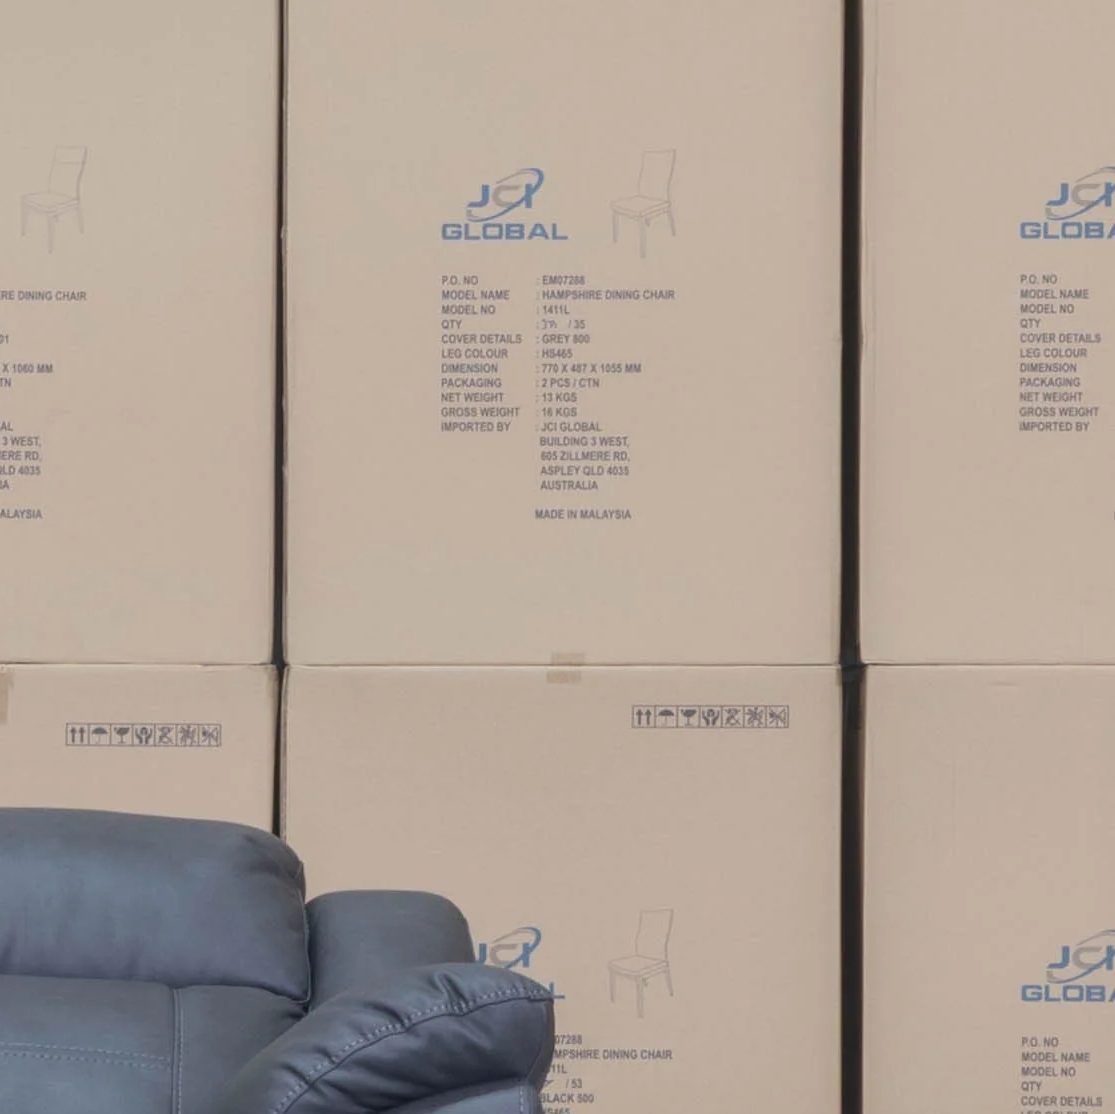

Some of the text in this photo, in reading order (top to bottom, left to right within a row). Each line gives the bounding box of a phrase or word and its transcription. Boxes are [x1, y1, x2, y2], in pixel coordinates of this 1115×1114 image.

[442, 223, 568, 240] GLOBAL
[18, 290, 53, 301] DINING
[55, 290, 87, 301] CHAIR
[441, 290, 510, 300] MODEL NAME
[542, 290, 675, 300] HAMPSHIRE DINING CHAIR
[1020, 289, 1089, 299] MODEL NAME
[441, 304, 478, 315] MODEL
[543, 305, 570, 315] 1411L
[1020, 303, 1057, 314] MODEL
[441, 319, 462, 330] QTY
[1020, 318, 1041, 329] QTY
[441, 334, 522, 344] COVER DETAILS
[542, 334, 570, 344] GREY
[1020, 333, 1102, 343] COVER DETAILS
[465, 348, 509, 359] COLOUR
[1044, 348, 1088, 358] COLOUR
[441, 363, 498, 373] DIMENSION
[1019, 362, 1077, 373] DIMENSION
[441, 378, 502, 388] PACKAGING
[1019, 377, 1081, 387] PACKAGING
[464, 392, 504, 402] WEIGHT
[1042, 392, 1083, 402] WEIGHT
[441, 407, 521, 417] GROSS WEIGHT
[1019, 406, 1099, 417] GROSS WEIGHT
[441, 421, 494, 432] IMPORTED
[559, 422, 603, 432] GLOBAL
[1019, 421, 1073, 432] IMPORTED
[539, 436, 588, 447] BUILDING
[560, 451, 610, 461] ZILLMERE
[540, 465, 580, 476] ASPLEY
[540, 480, 598, 490] AUSTRALIA
[535, 509, 632, 520] MADE MALAYSIA
[602, 1049, 673, 1060] DINING CHAIR
[1021, 1052, 1090, 1062] MODEL NAME
[1021, 1066, 1058, 1077] MODEL
[1020, 1081, 1042, 1092] QTY
[1020, 1096, 1103, 1107] COVER DETAILS
